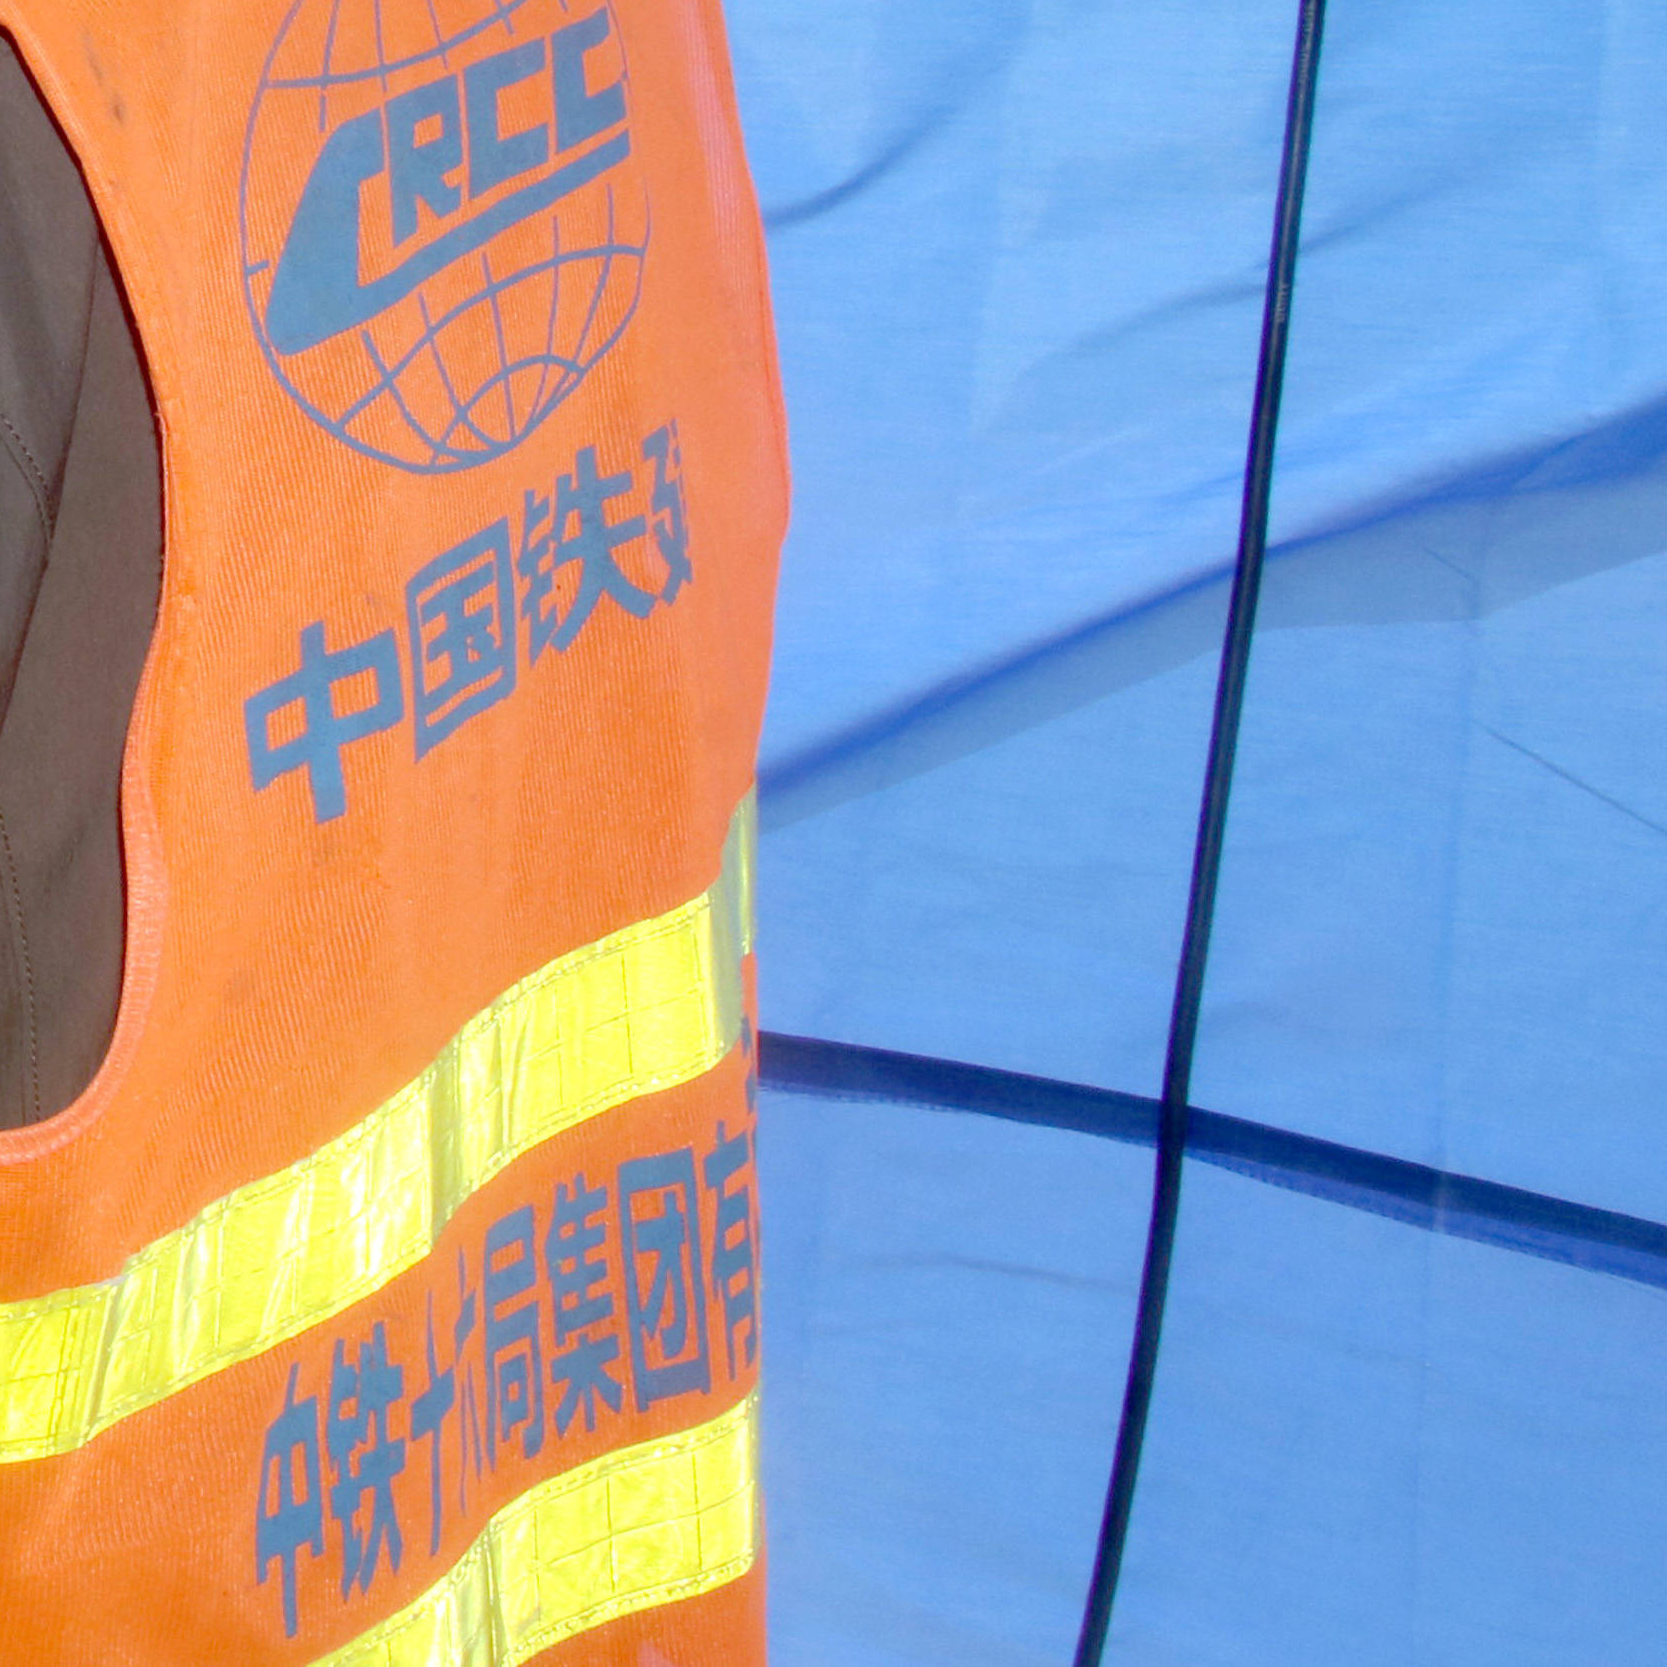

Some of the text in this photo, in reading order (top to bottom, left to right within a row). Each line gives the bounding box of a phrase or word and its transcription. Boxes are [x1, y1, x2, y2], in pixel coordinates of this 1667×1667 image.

[265, 6, 630, 356] CRCC
[256, 1120, 758, 1638] 中铁十局集团有
